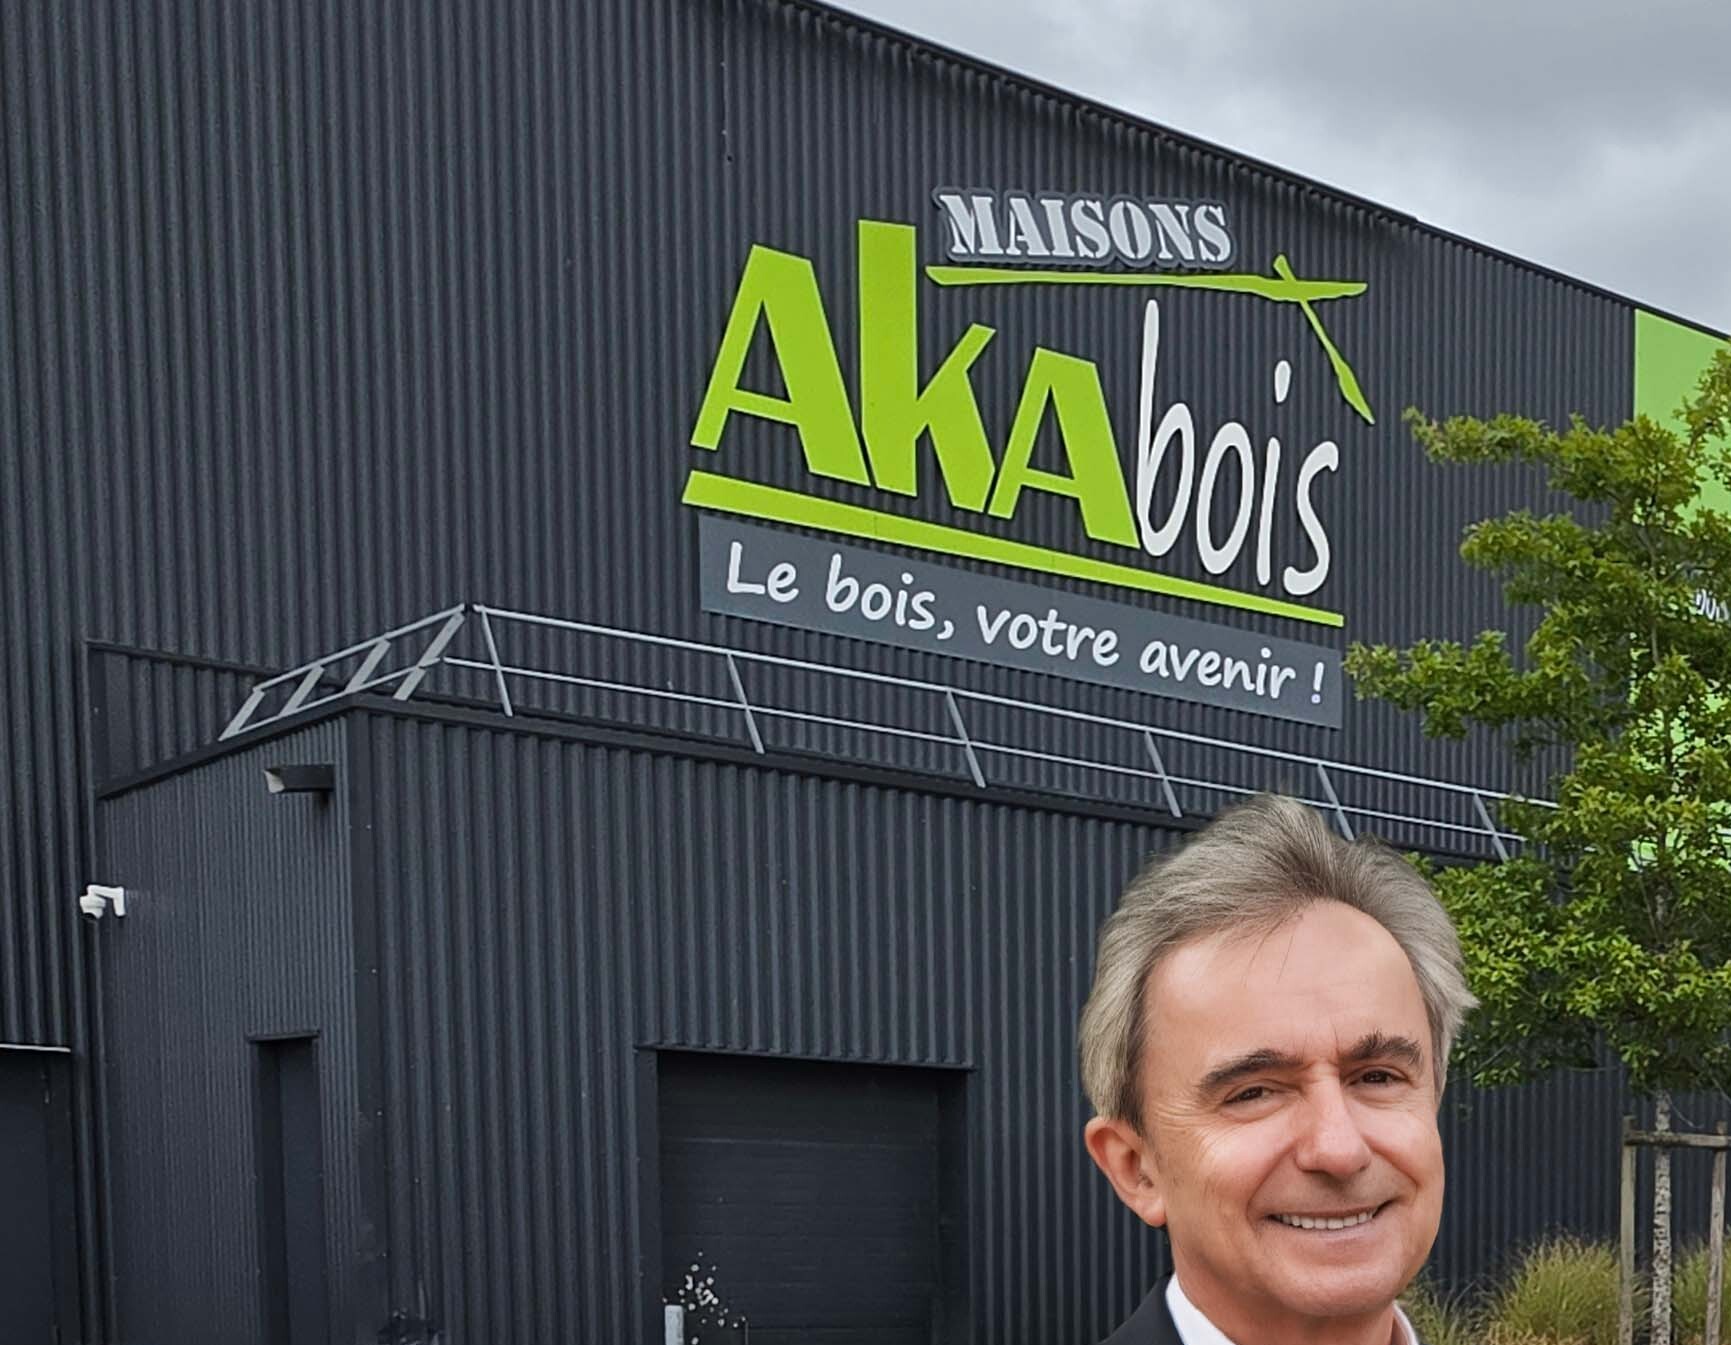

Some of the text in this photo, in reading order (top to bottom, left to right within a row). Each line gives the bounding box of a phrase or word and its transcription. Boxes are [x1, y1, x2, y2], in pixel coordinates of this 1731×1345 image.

[937, 193, 1232, 263] MAISONS
[727, 542, 799, 602] Le
[825, 553, 955, 640] bois,
[977, 605, 1120, 667] votre
[1140, 640, 1296, 697] avenir
